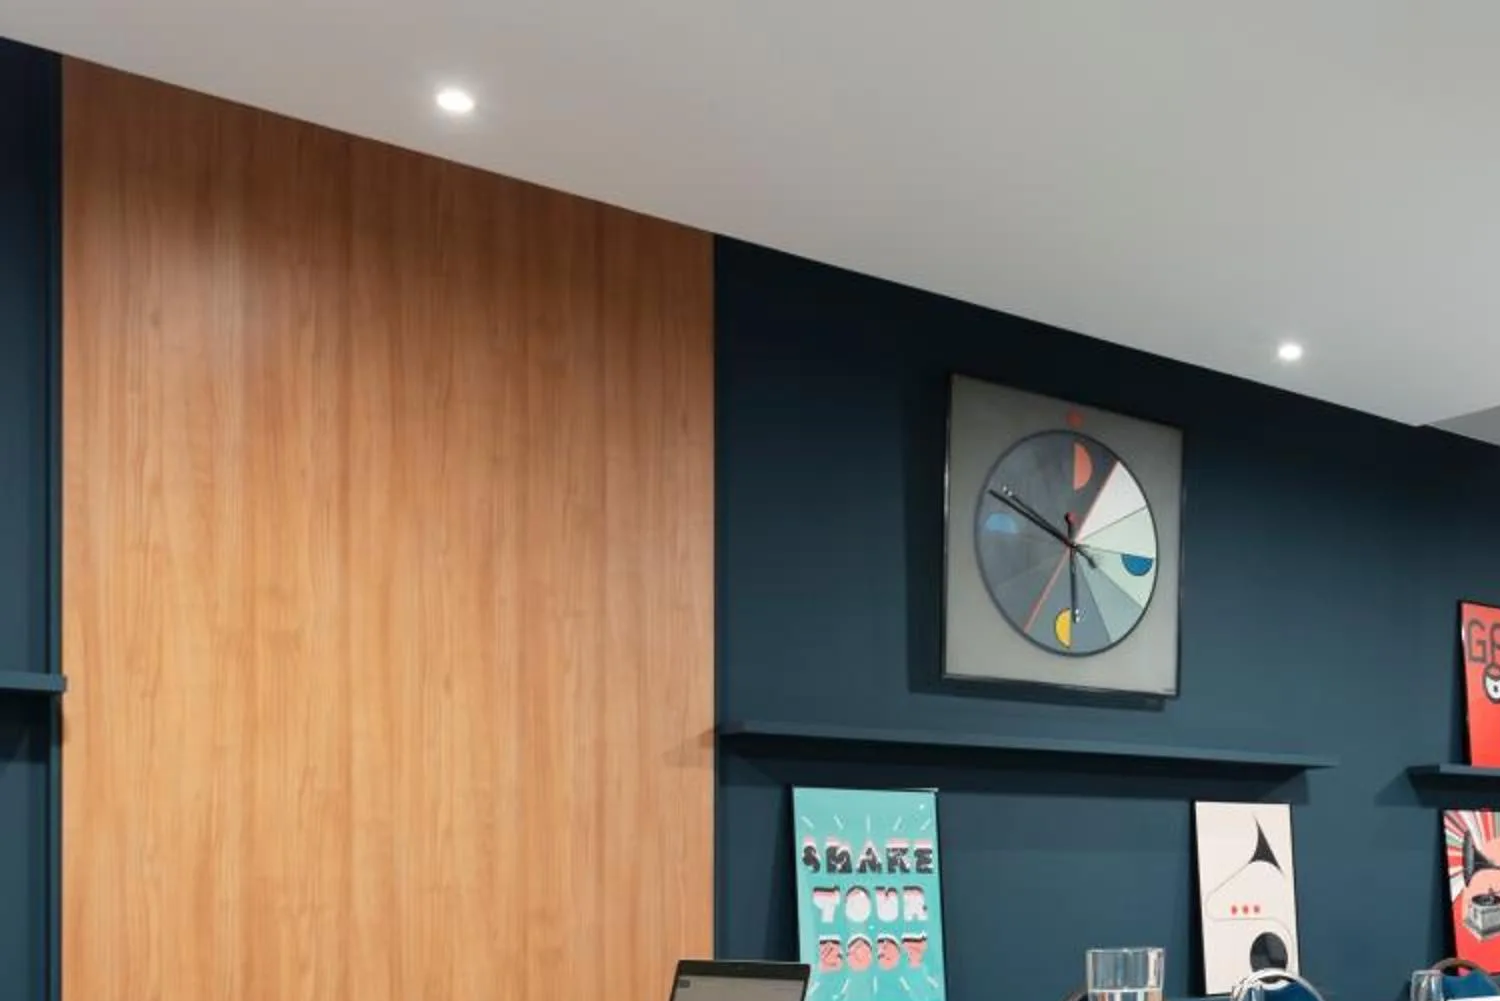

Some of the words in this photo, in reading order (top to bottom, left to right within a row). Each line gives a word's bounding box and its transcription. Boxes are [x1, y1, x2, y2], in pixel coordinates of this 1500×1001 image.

[802, 836, 933, 874] SHAKE
[812, 885, 928, 923] YOUR
[819, 933, 928, 972] BODY
